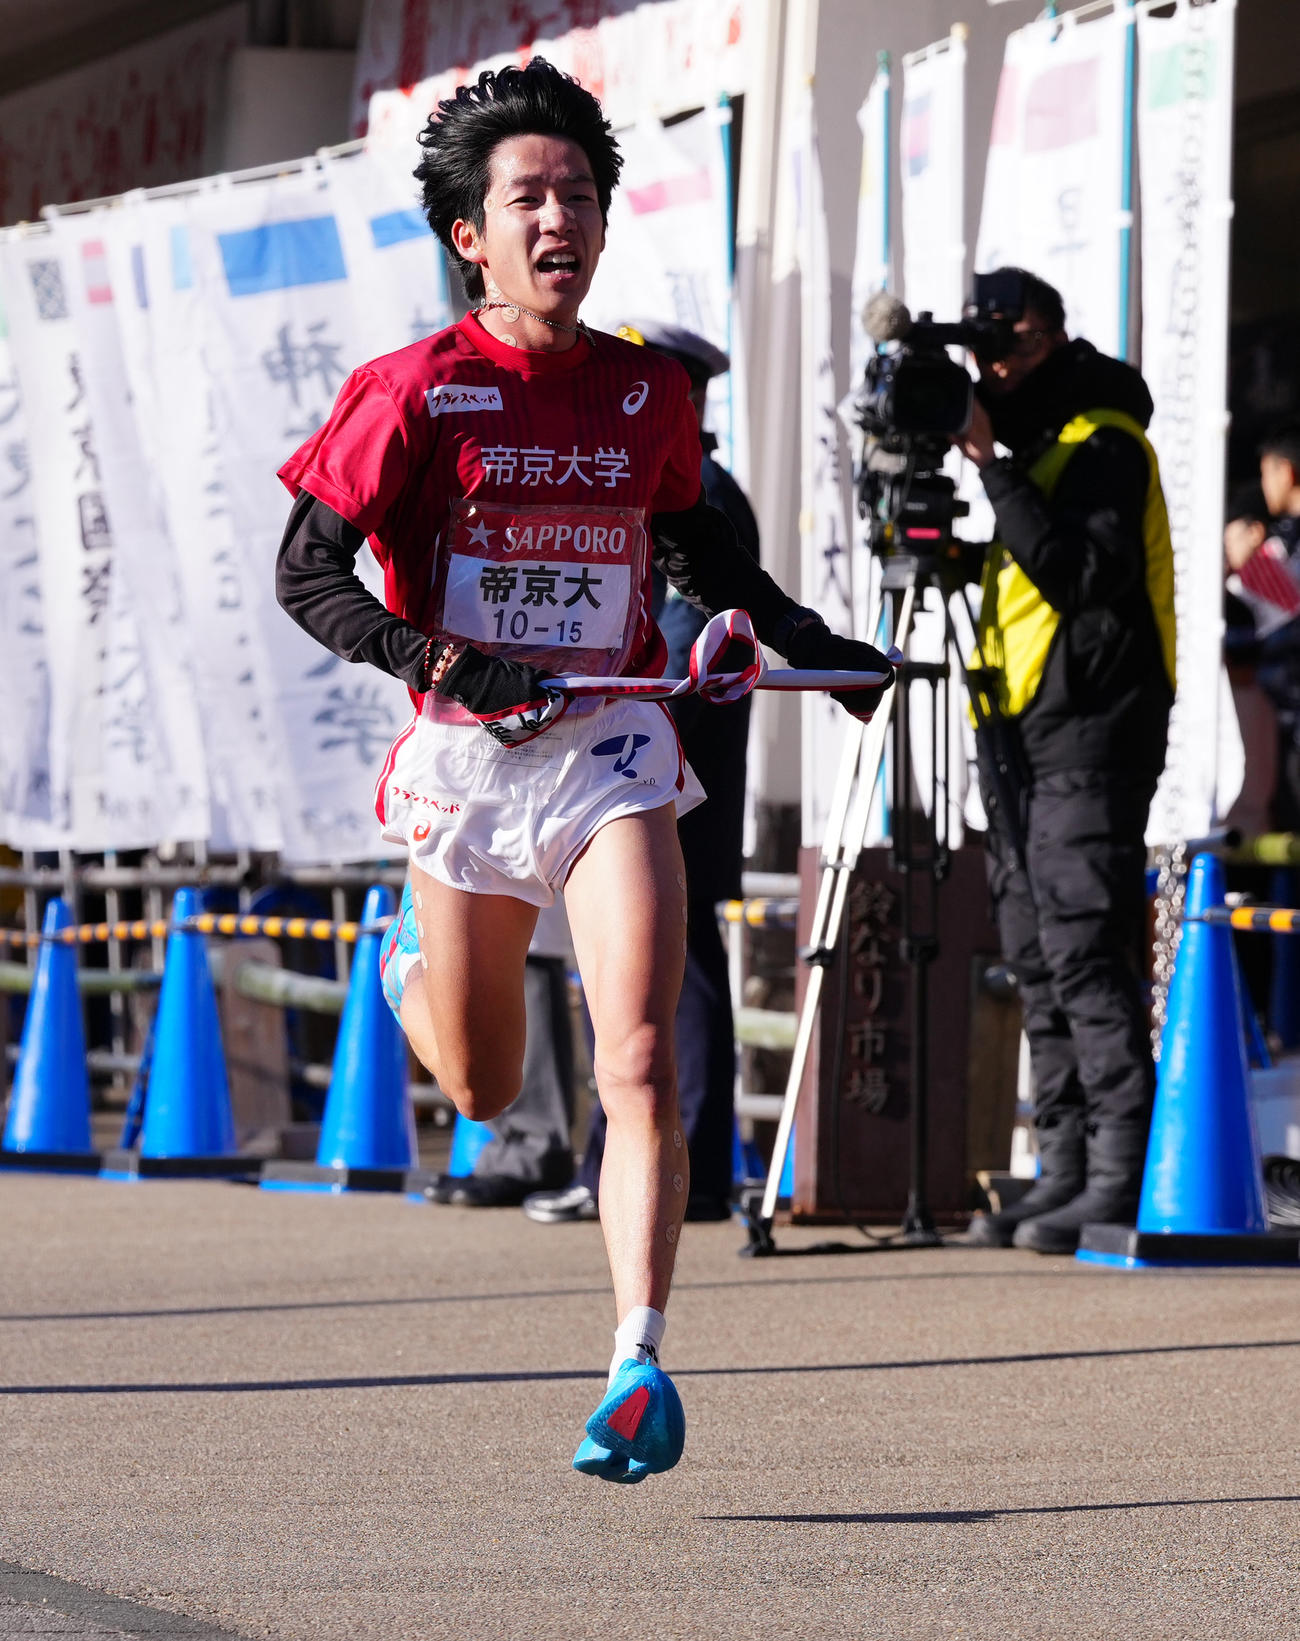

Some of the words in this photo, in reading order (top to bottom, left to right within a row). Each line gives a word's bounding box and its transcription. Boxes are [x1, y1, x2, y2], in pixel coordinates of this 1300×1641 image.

[480, 445, 631, 488] 帝京大学
[502, 525, 627, 554] SAPPORO
[479, 565, 602, 610] 帝京大
